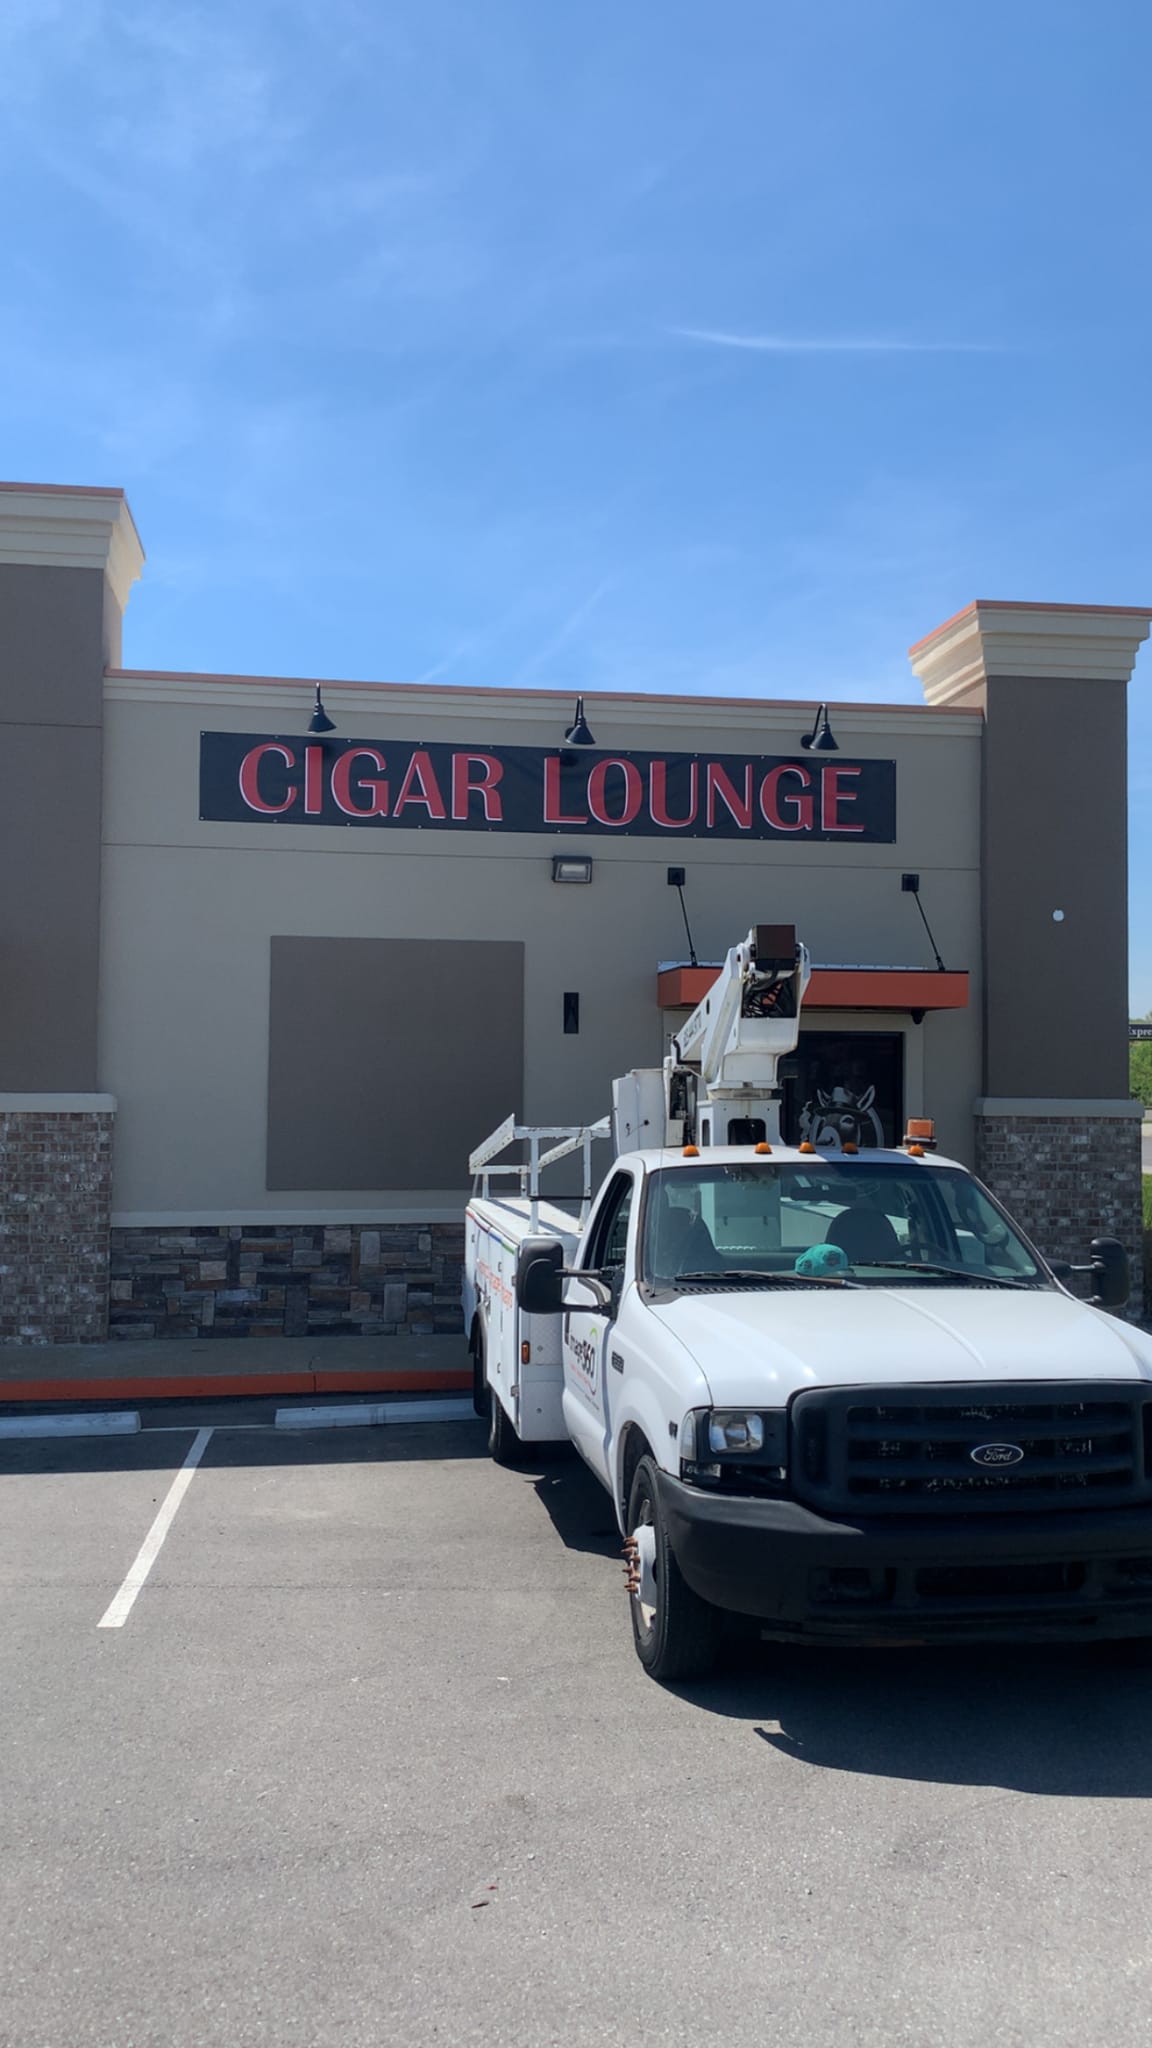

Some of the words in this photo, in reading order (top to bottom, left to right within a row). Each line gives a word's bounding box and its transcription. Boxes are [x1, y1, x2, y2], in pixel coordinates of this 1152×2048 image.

[239, 743, 503, 821] CIGAR
[542, 756, 865, 833] LOUNGE
[984, 1448, 1012, 1462] Ford
